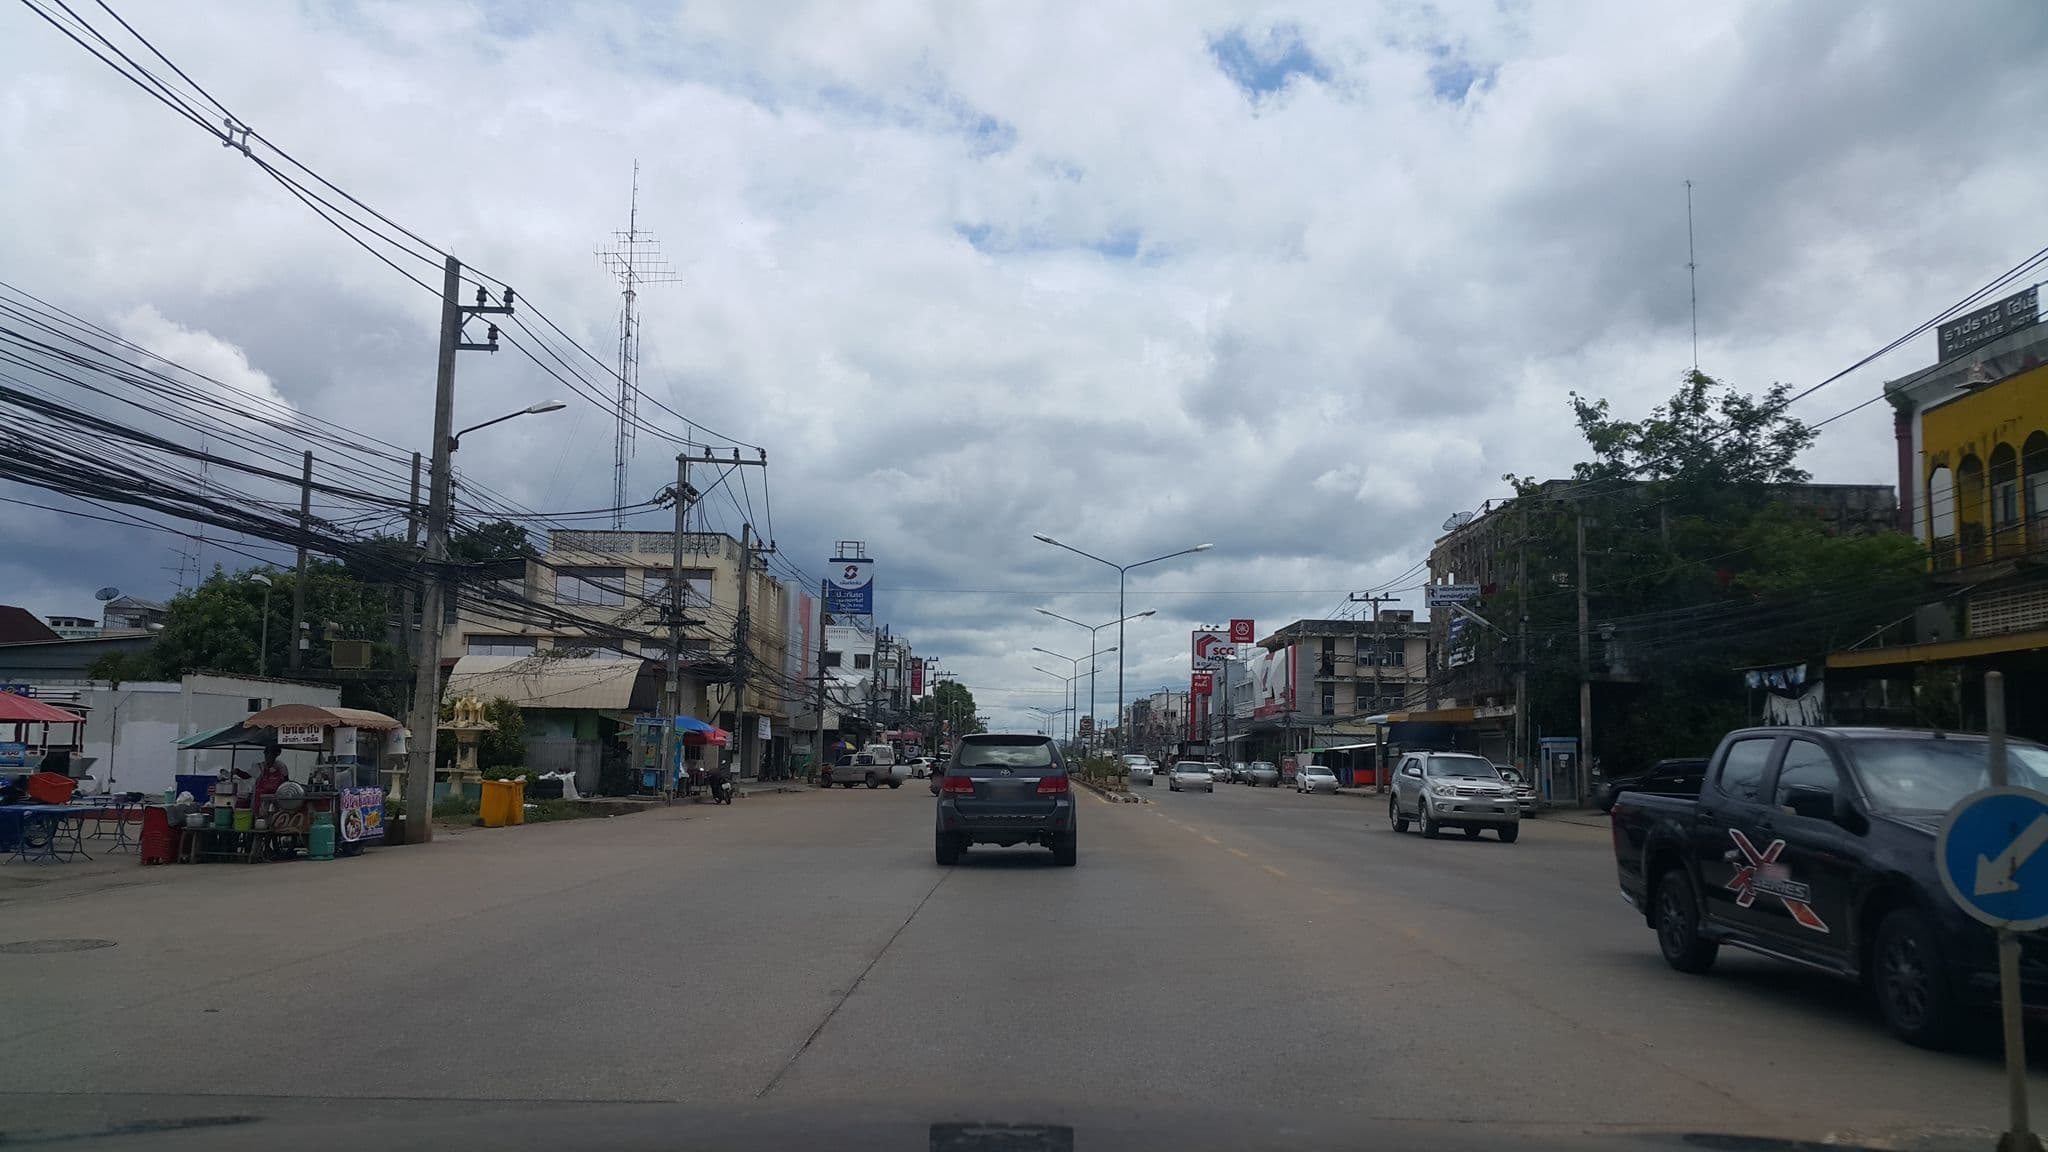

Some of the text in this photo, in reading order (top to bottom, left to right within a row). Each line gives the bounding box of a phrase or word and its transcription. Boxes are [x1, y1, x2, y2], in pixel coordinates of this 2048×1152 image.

[2010, 311, 2038, 328] HOTE
[1213, 647, 1235, 656] SCG
[1753, 879, 1805, 898] SERIES
